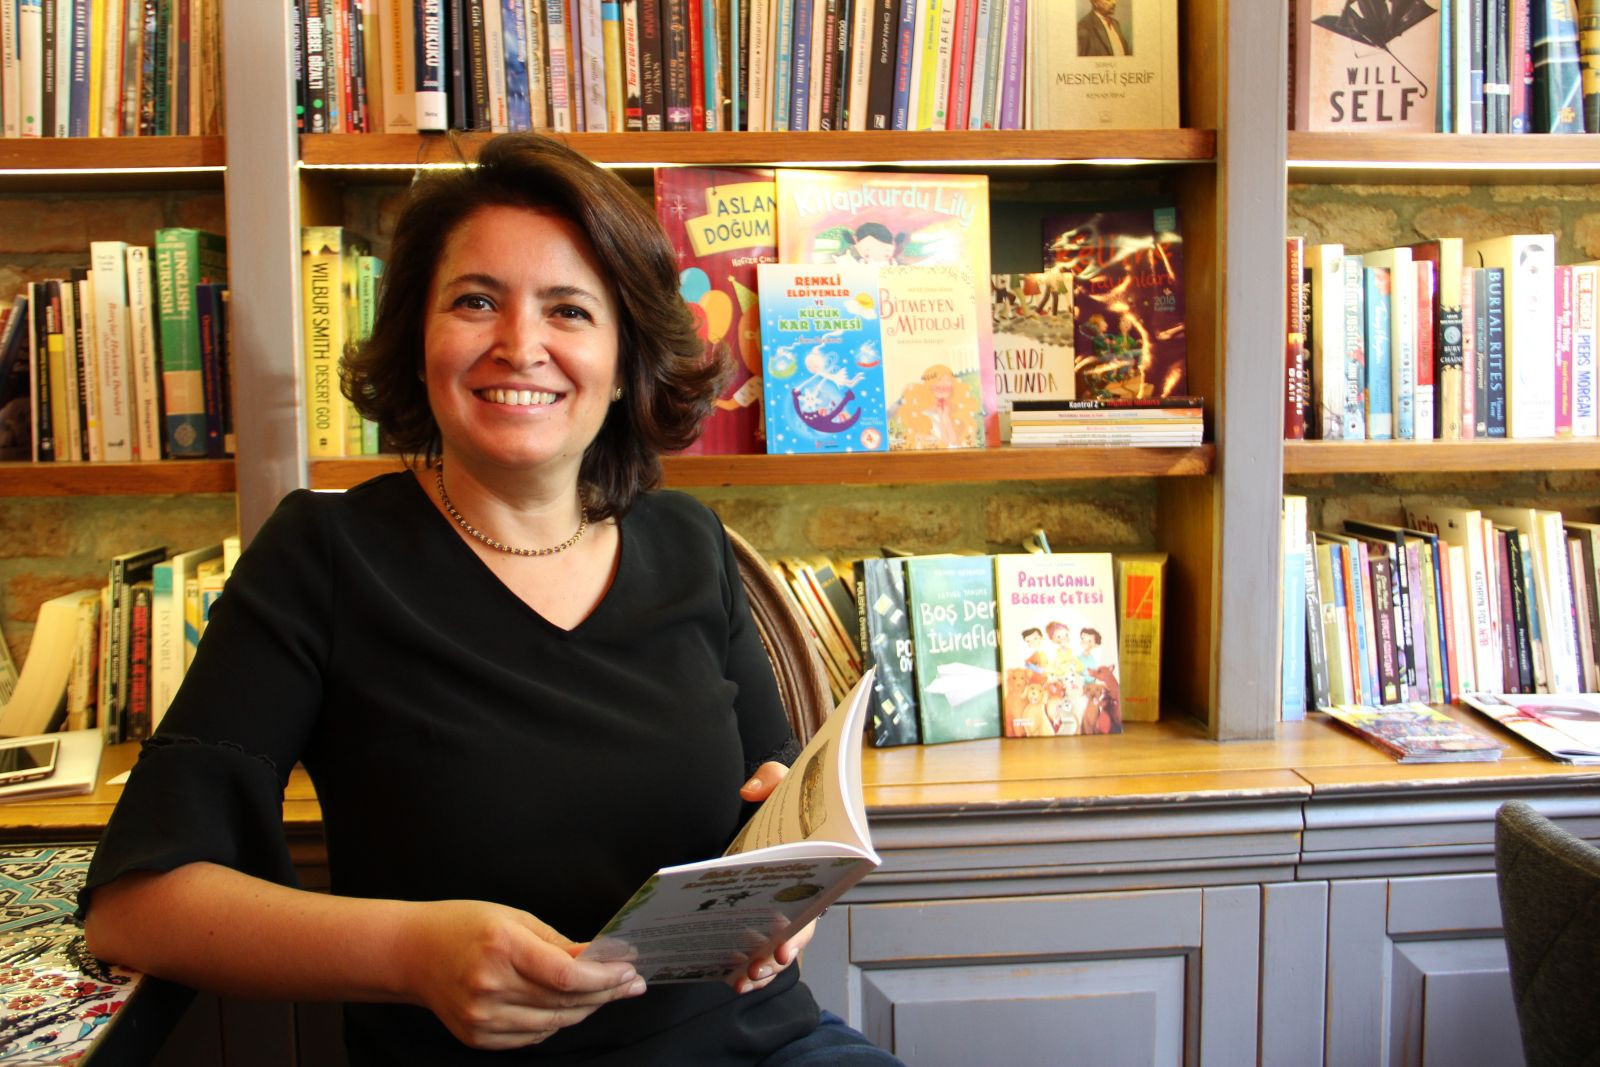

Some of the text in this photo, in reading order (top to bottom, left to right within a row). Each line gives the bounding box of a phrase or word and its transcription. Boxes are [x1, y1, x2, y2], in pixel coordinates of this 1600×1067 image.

[472, 6, 480, 27] Girls
[938, 7, 951, 54] RAFET
[74, 6, 86, 82] EAST ASIAN MIRACLE
[307, 17, 324, 54] KÜRESEL
[425, 0, 440, 67] AR HUKUKU
[549, 0, 568, 109] OCTOR LIBERATION
[1119, 70, 1156, 87] ŞERİF
[1347, 65, 1401, 85] WILL
[1329, 87, 1419, 122] SELF
[716, 195, 776, 218] ASLAN
[794, 183, 976, 228] Kitapkurdu Lily
[703, 219, 771, 245] DOĞUM
[158, 251, 174, 315] TURKISH
[794, 273, 842, 287] RENKLİ
[879, 288, 955, 320] BİTMEYEN
[778, 317, 863, 332] KAR TANESİ
[887, 314, 966, 336] MİTOLOJİ
[1347, 315, 1360, 351] JUSTICE
[1489, 271, 1503, 392] BURIAL RITES
[312, 262, 331, 430] WILBUR SMITH DESERT GOD
[994, 347, 1045, 371] KENDİ
[1577, 334, 1592, 367] PIERS
[1295, 354, 1303, 382] WHO
[994, 372, 1059, 394] OLUNDA
[1288, 367, 1296, 402] DEATH
[1577, 370, 1592, 418] MORGAN
[1069, 401, 1093, 409] Kontrol
[1018, 571, 1095, 588] PATLICANLI
[1011, 589, 1104, 606] BÖREK ÇETESİ
[920, 599, 996, 627] Boş Der
[896, 639, 913, 658] PO
[928, 623, 1000, 654] İtirafla
